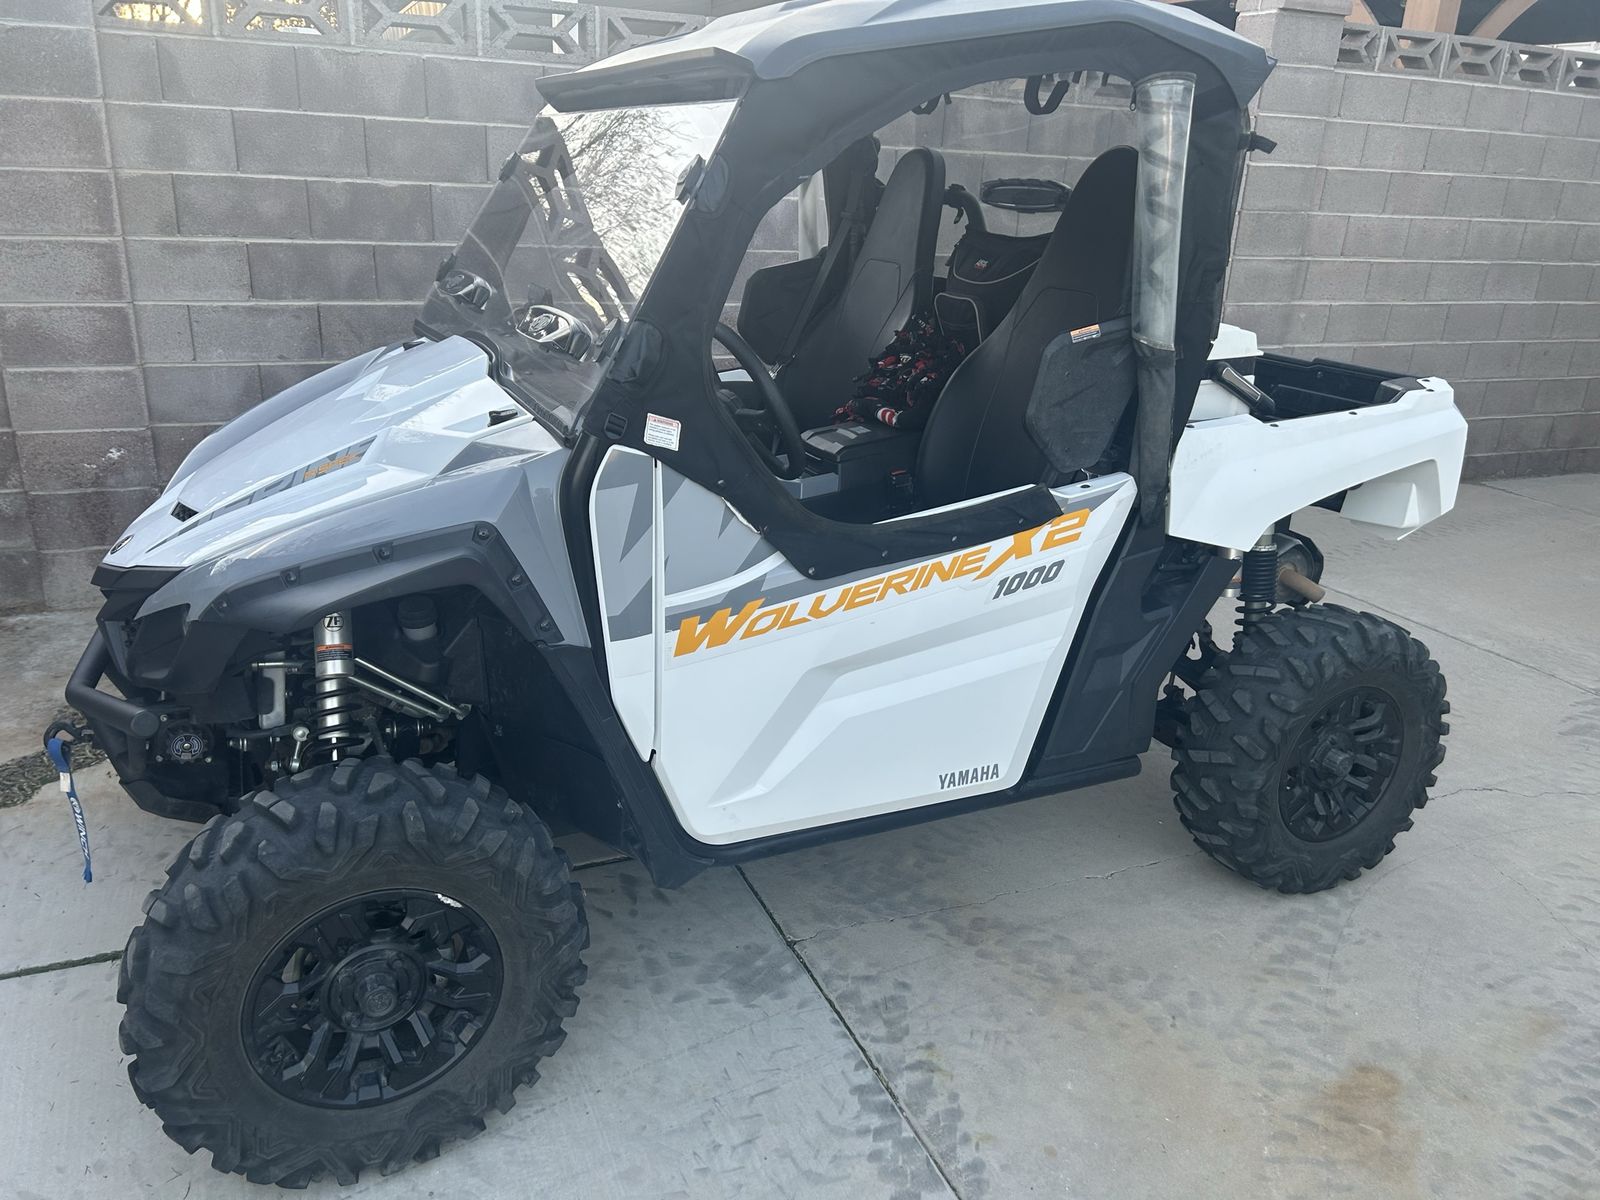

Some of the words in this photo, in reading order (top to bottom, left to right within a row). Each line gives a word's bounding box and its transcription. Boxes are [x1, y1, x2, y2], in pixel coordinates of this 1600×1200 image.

[992, 559, 1065, 600] 1000
[674, 546, 992, 657] WOLVERINE
[324, 615, 343, 628] ZF
[939, 763, 999, 790] YAMAHA
